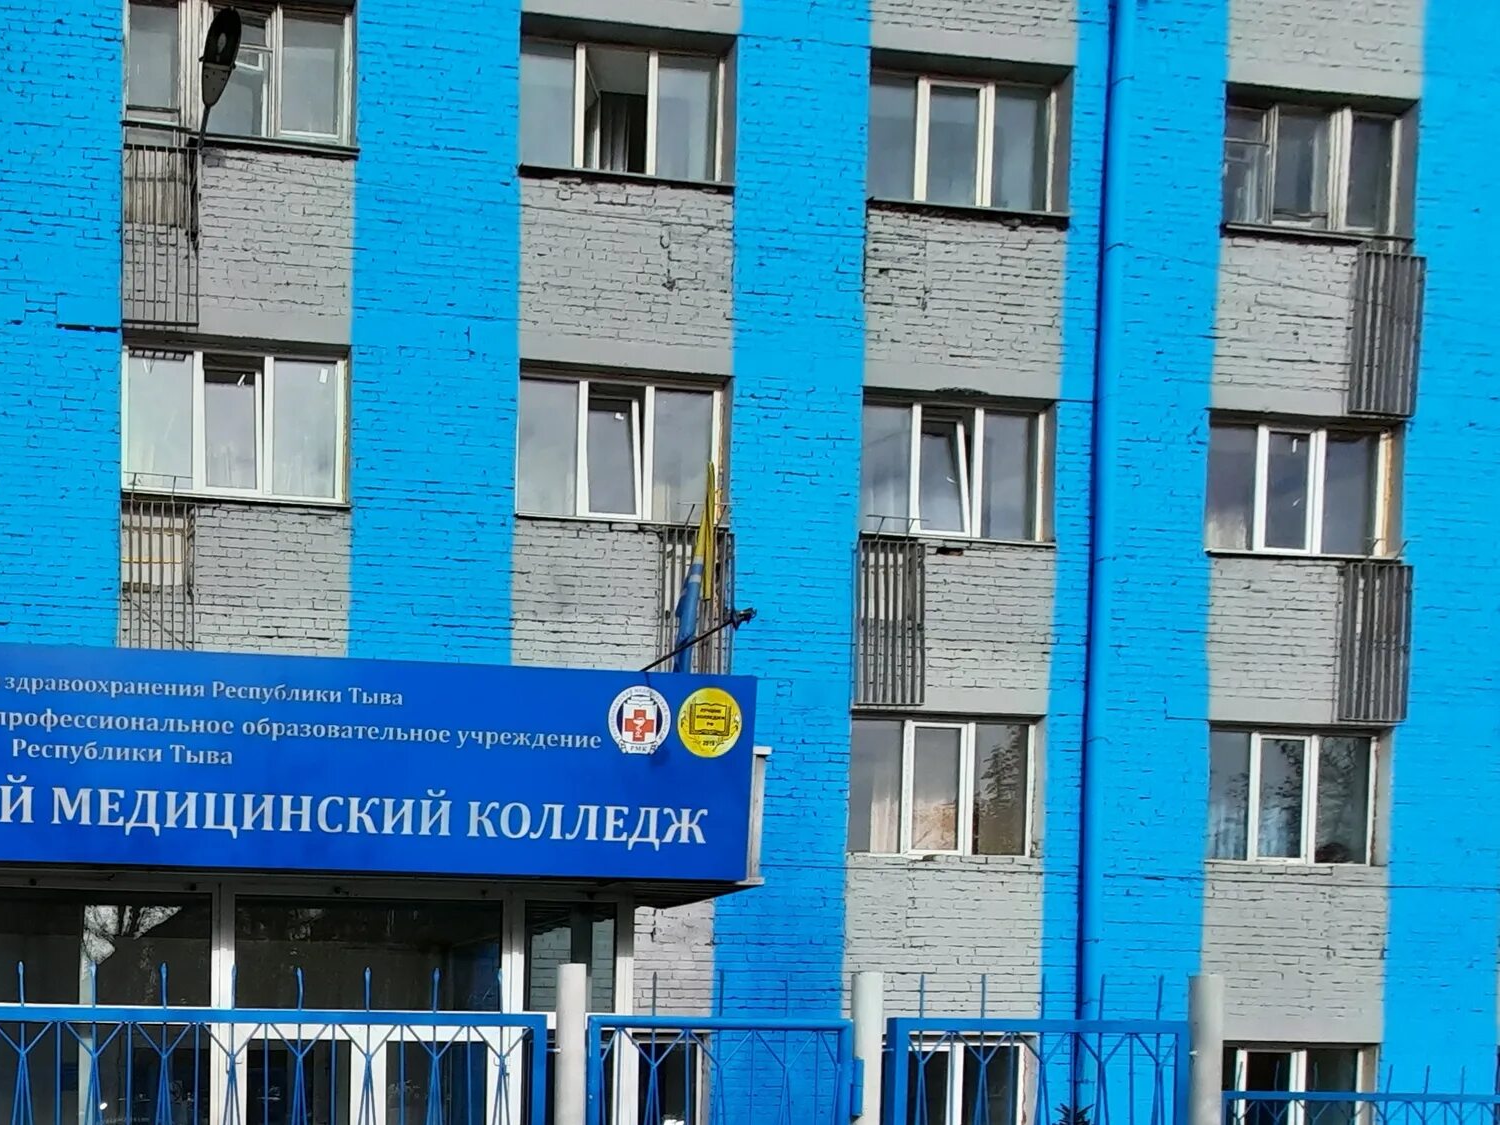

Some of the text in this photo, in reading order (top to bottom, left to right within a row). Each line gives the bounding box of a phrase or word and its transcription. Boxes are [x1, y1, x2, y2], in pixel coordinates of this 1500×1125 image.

[4, 676, 206, 698] здравоохранения
[212, 681, 343, 706] Республики
[348, 687, 404, 706] Тыва
[241, 717, 451, 743] образовательное
[456, 730, 603, 749] учреждение
[11, 738, 234, 767] Республики Тыва
[51, 787, 452, 839] МЕДИЦИНСКИЙ
[467, 801, 709, 851] КОЛЛЕДЖ
